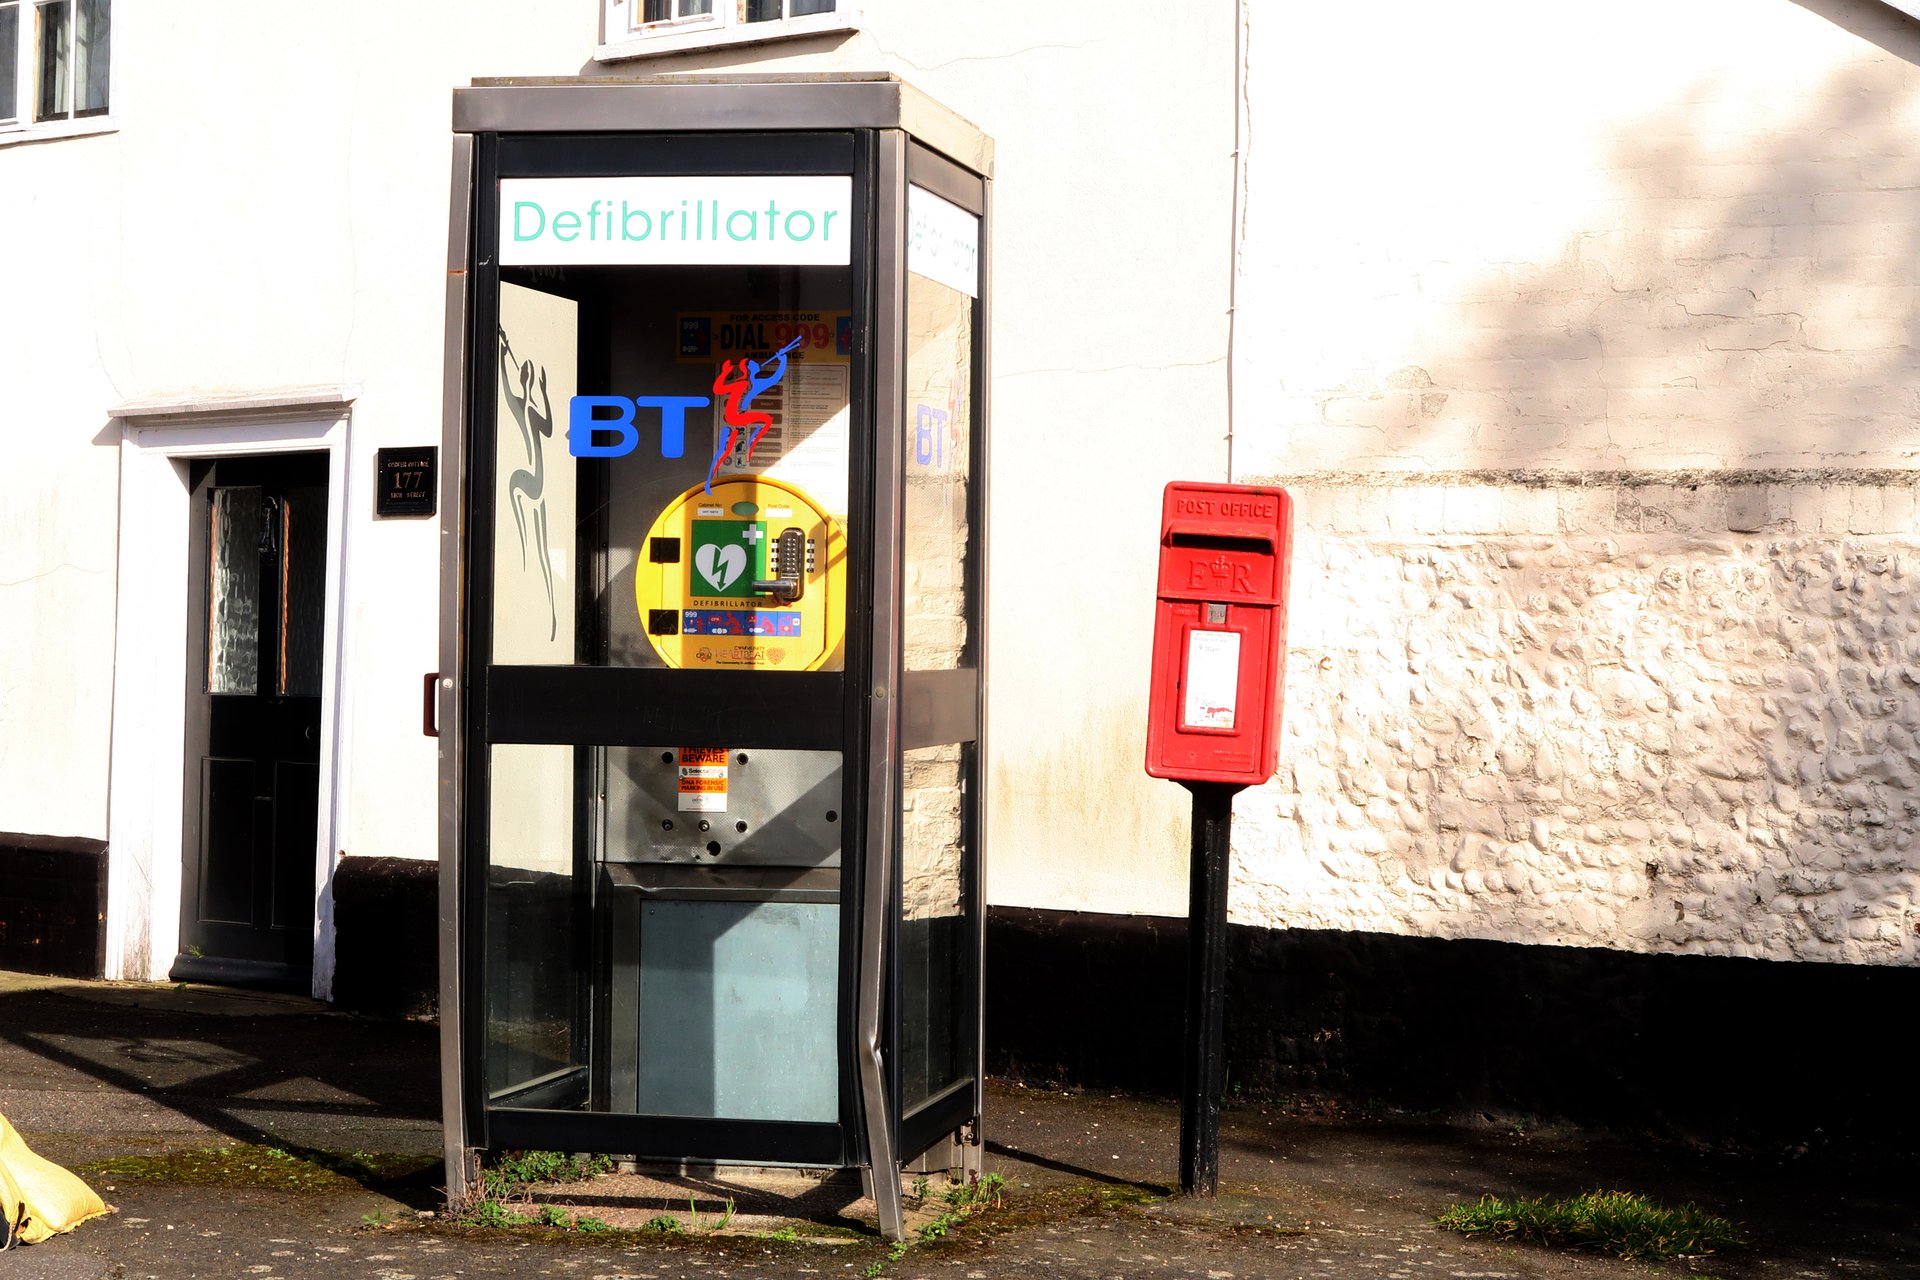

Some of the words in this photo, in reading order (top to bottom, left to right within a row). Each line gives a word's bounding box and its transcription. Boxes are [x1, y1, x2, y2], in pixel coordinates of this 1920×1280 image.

[513, 199, 837, 242] Defibrillator
[720, 324, 769, 350] DIAL
[775, 323, 830, 349] 999
[744, 351, 805, 359] AMBUNCE
[569, 395, 710, 458] BT
[916, 403, 948, 468] BT
[393, 471, 423, 489] 177
[1177, 498, 1216, 515] POST
[1220, 500, 1273, 518] OFFICE
[693, 600, 763, 608] DEFIBRILLATOR
[682, 754, 725, 763] BEWARE
